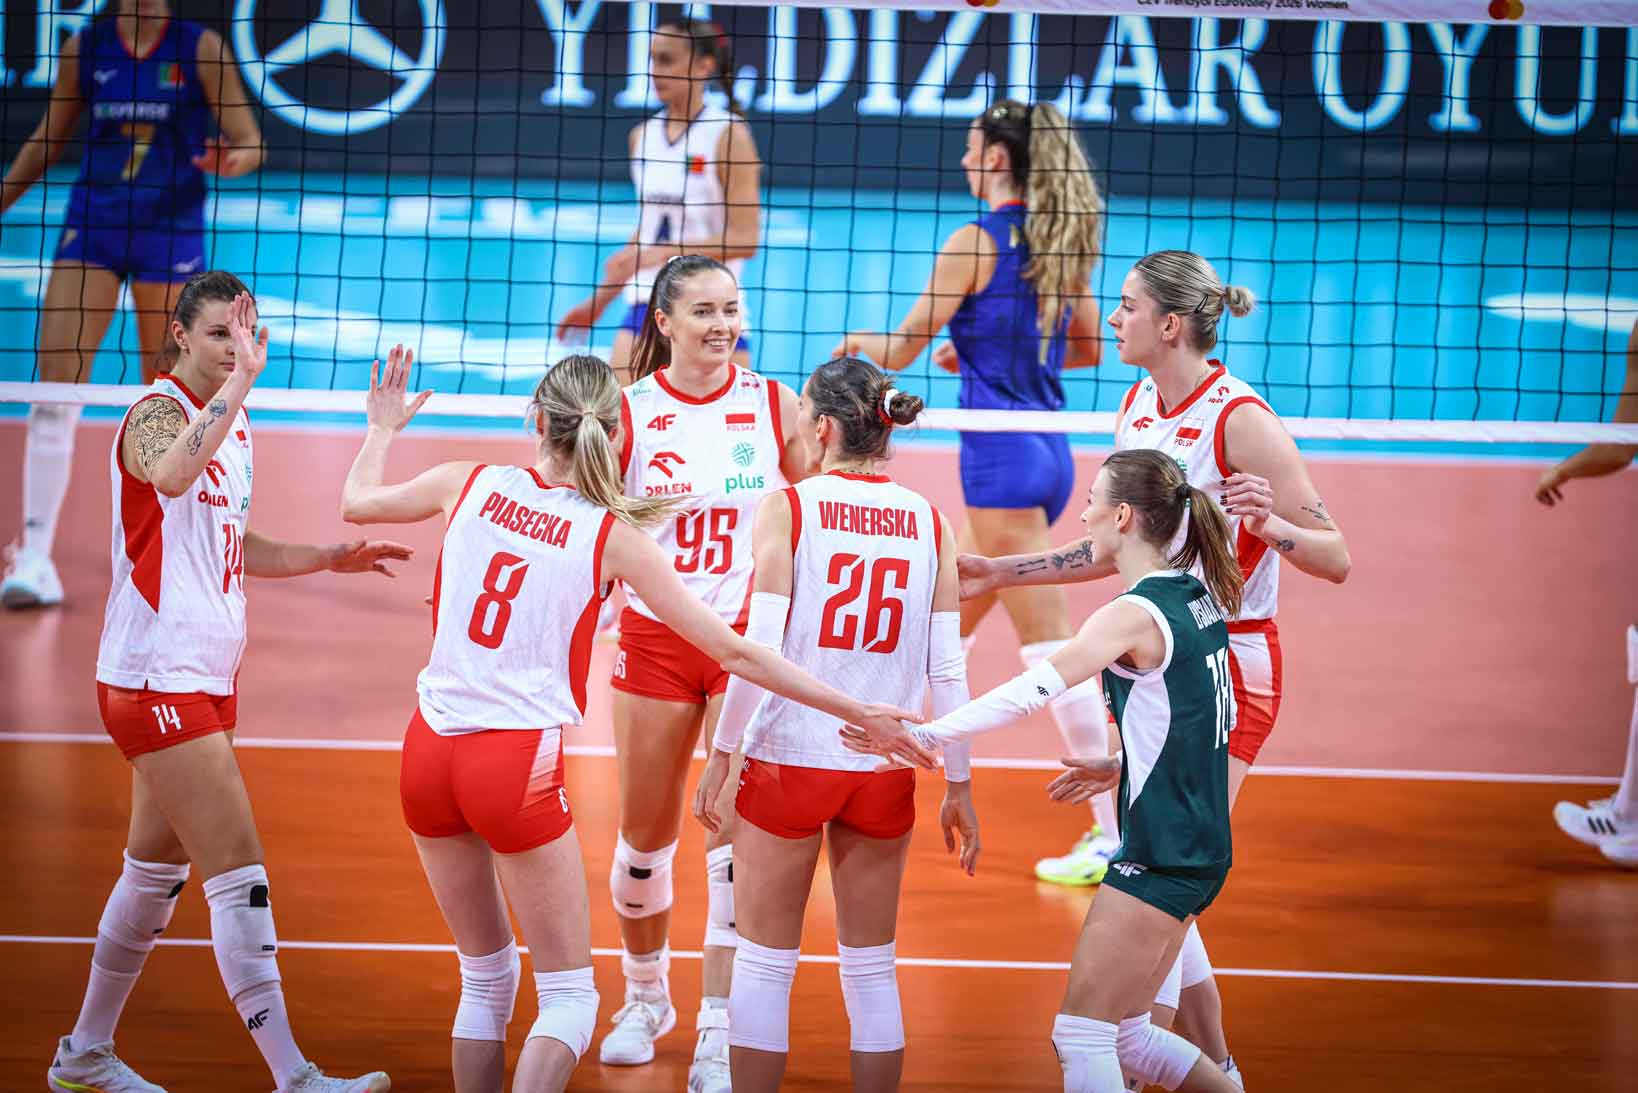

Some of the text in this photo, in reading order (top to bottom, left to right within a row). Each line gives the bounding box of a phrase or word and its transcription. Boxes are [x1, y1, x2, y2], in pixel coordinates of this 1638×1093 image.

[119, 122, 156, 181] 7
[647, 414, 677, 431] 4F
[725, 472, 765, 494] plus
[479, 491, 573, 550] PIASECKA
[674, 507, 738, 574] 95
[818, 500, 919, 540] WENERSKA
[468, 551, 530, 650] 8
[817, 552, 910, 654] 26
[151, 703, 183, 735] 14
